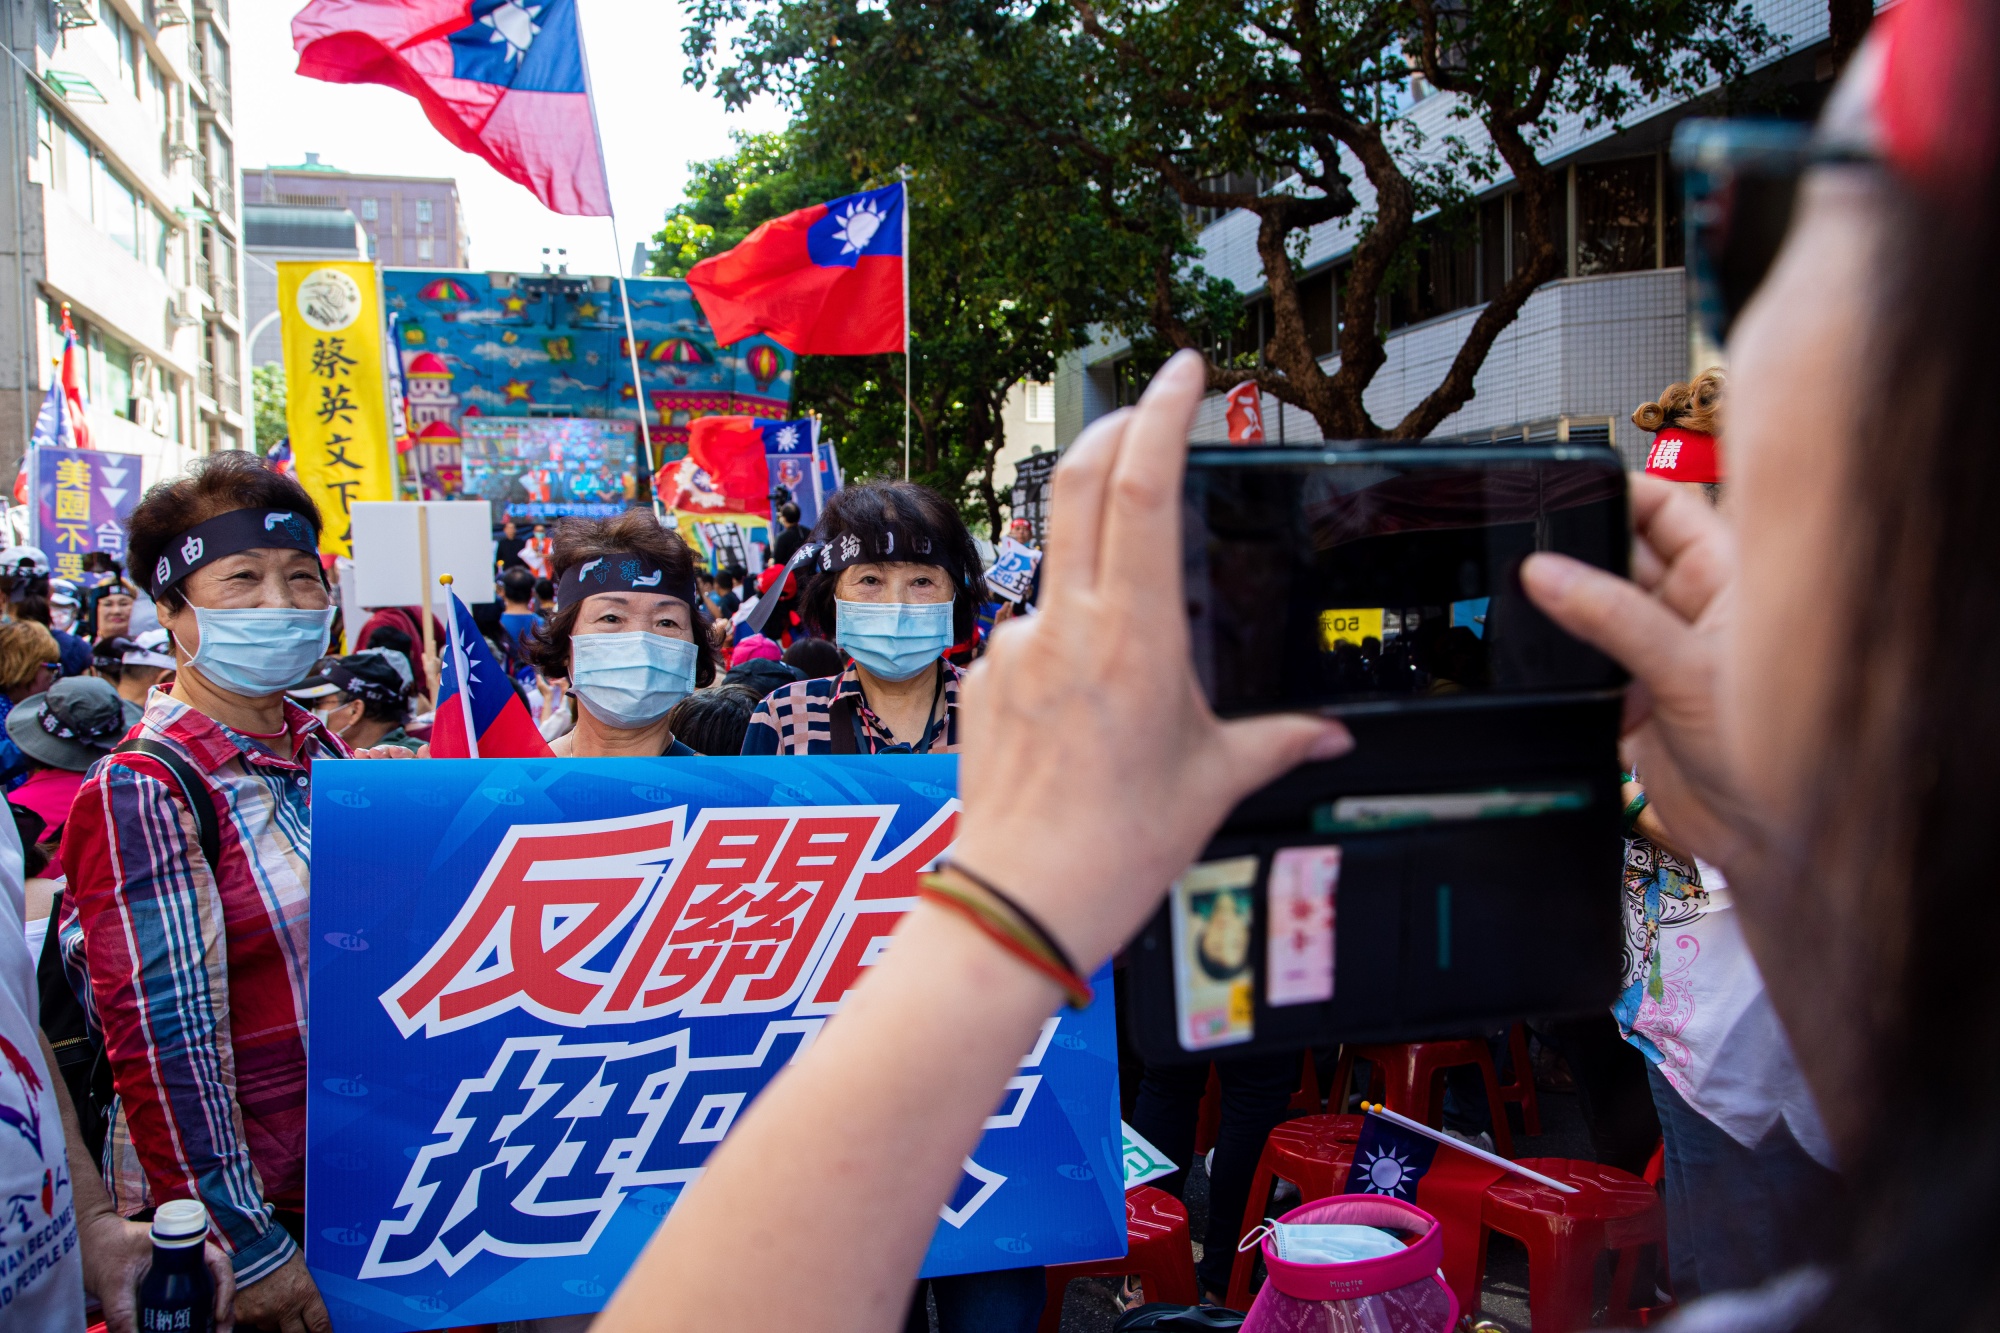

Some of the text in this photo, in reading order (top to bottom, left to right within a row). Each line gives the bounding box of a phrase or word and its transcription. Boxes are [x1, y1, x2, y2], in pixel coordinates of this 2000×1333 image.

[311, 336, 365, 560] 蔡英文下
[1645, 438, 1684, 470] 議
[55, 458, 91, 583] 美國不要
[156, 535, 204, 585] 自由
[28, 1203, 73, 1255] BECOME
[15, 1245, 61, 1294] PEOPLE
[1329, 1278, 1363, 1288] Minette
[144, 1307, 192, 1331] 貝納頌
